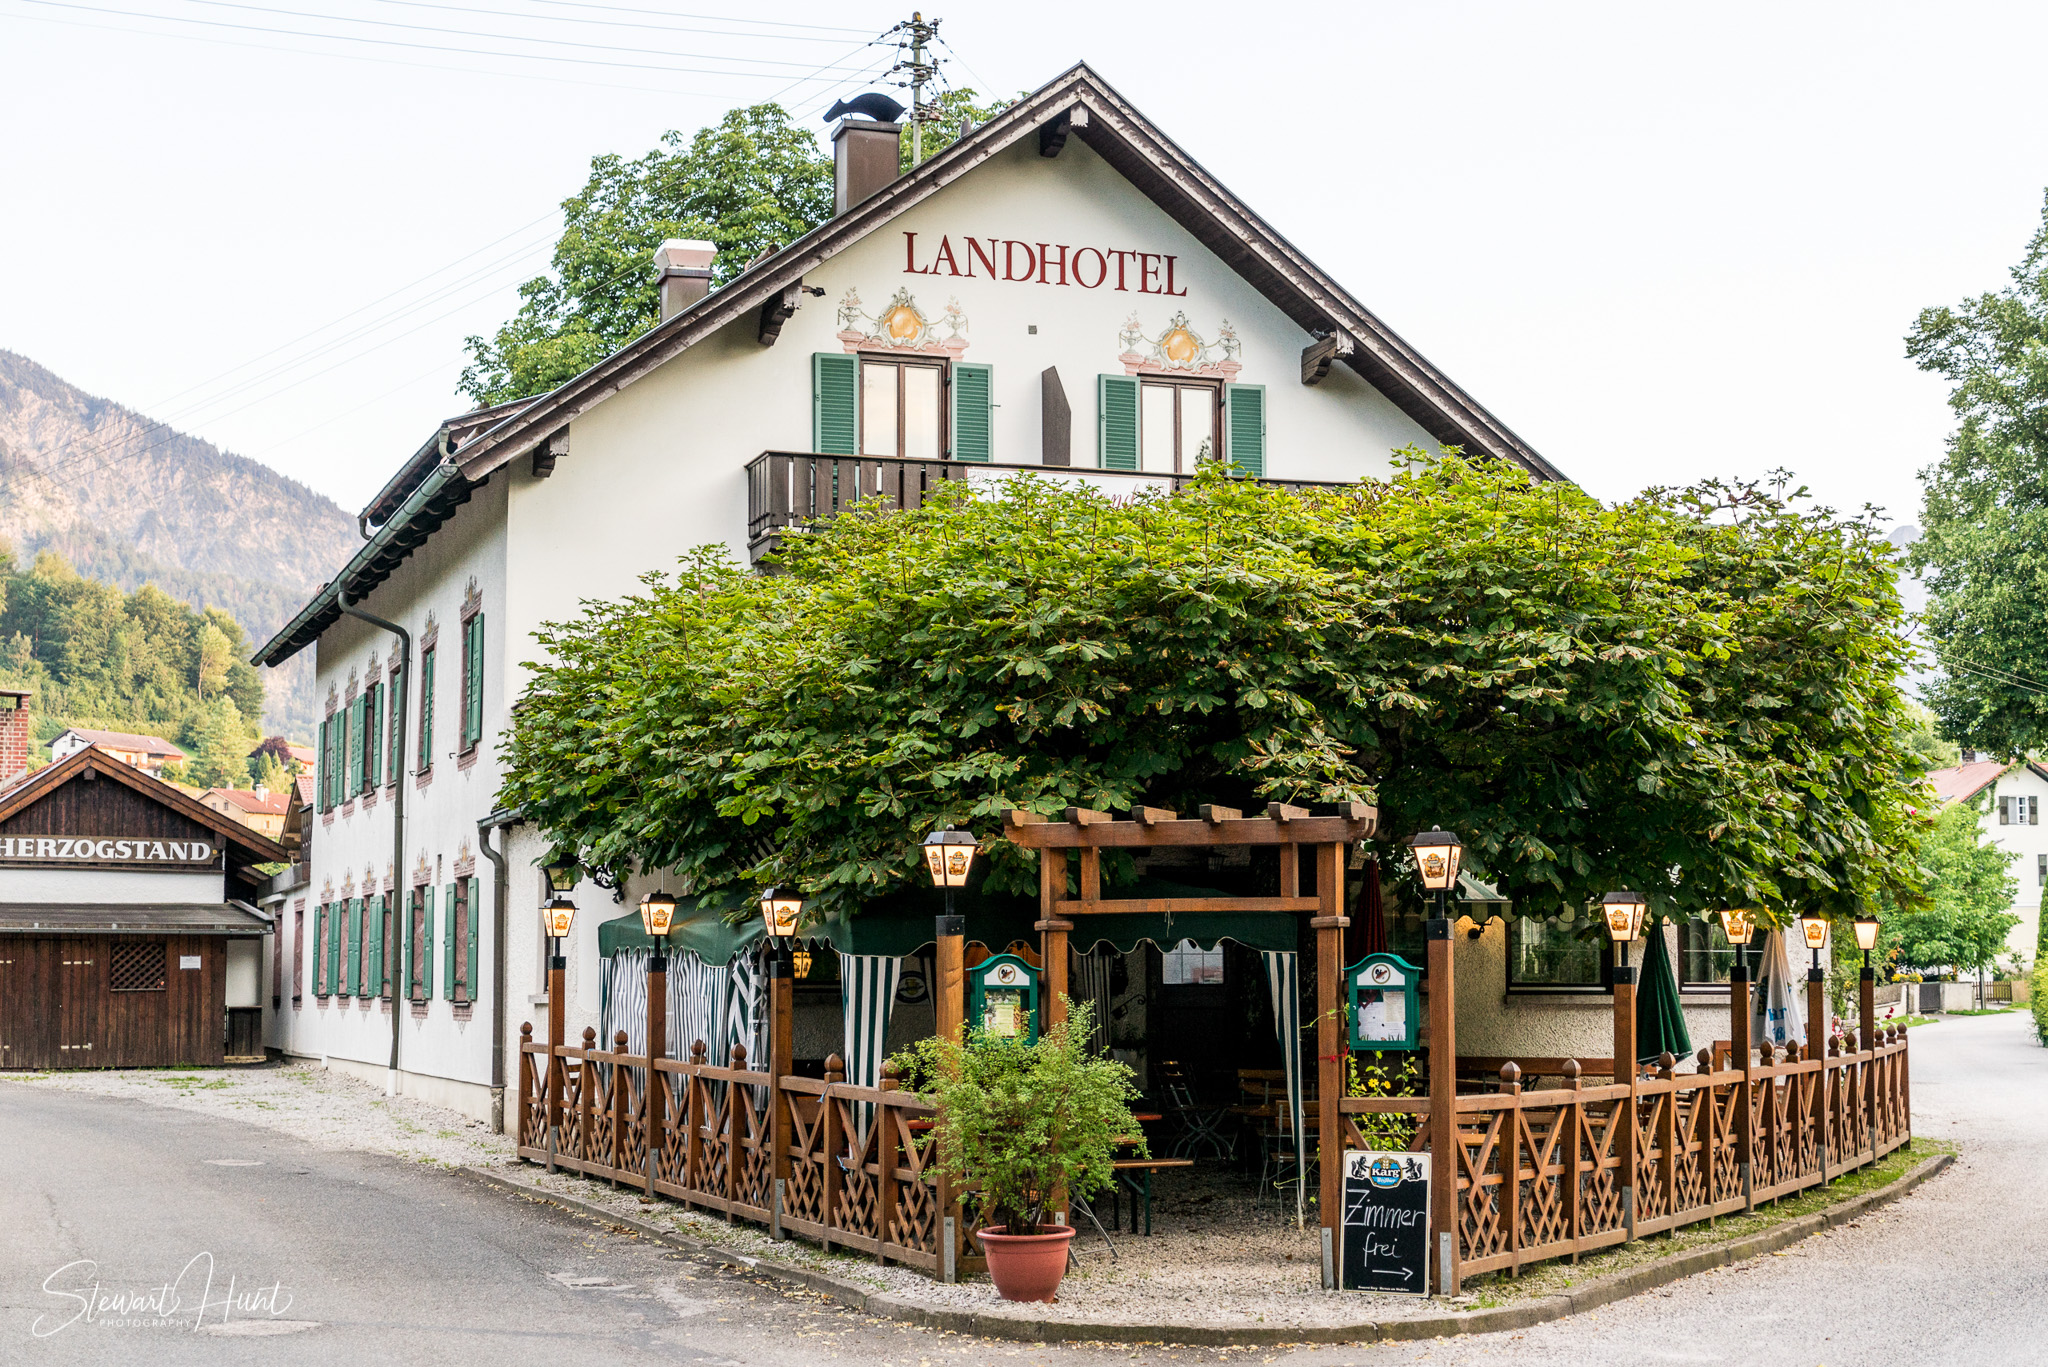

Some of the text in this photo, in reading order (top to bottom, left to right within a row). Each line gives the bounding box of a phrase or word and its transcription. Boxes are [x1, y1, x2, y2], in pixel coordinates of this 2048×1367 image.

[902, 231, 1188, 297] LANDHOTEL
[0, 838, 211, 861] HERZOGSTAND
[1371, 1168, 1401, 1178] Karg
[1344, 1188, 1426, 1229] Zimmer
[1362, 1231, 1402, 1268] frei
